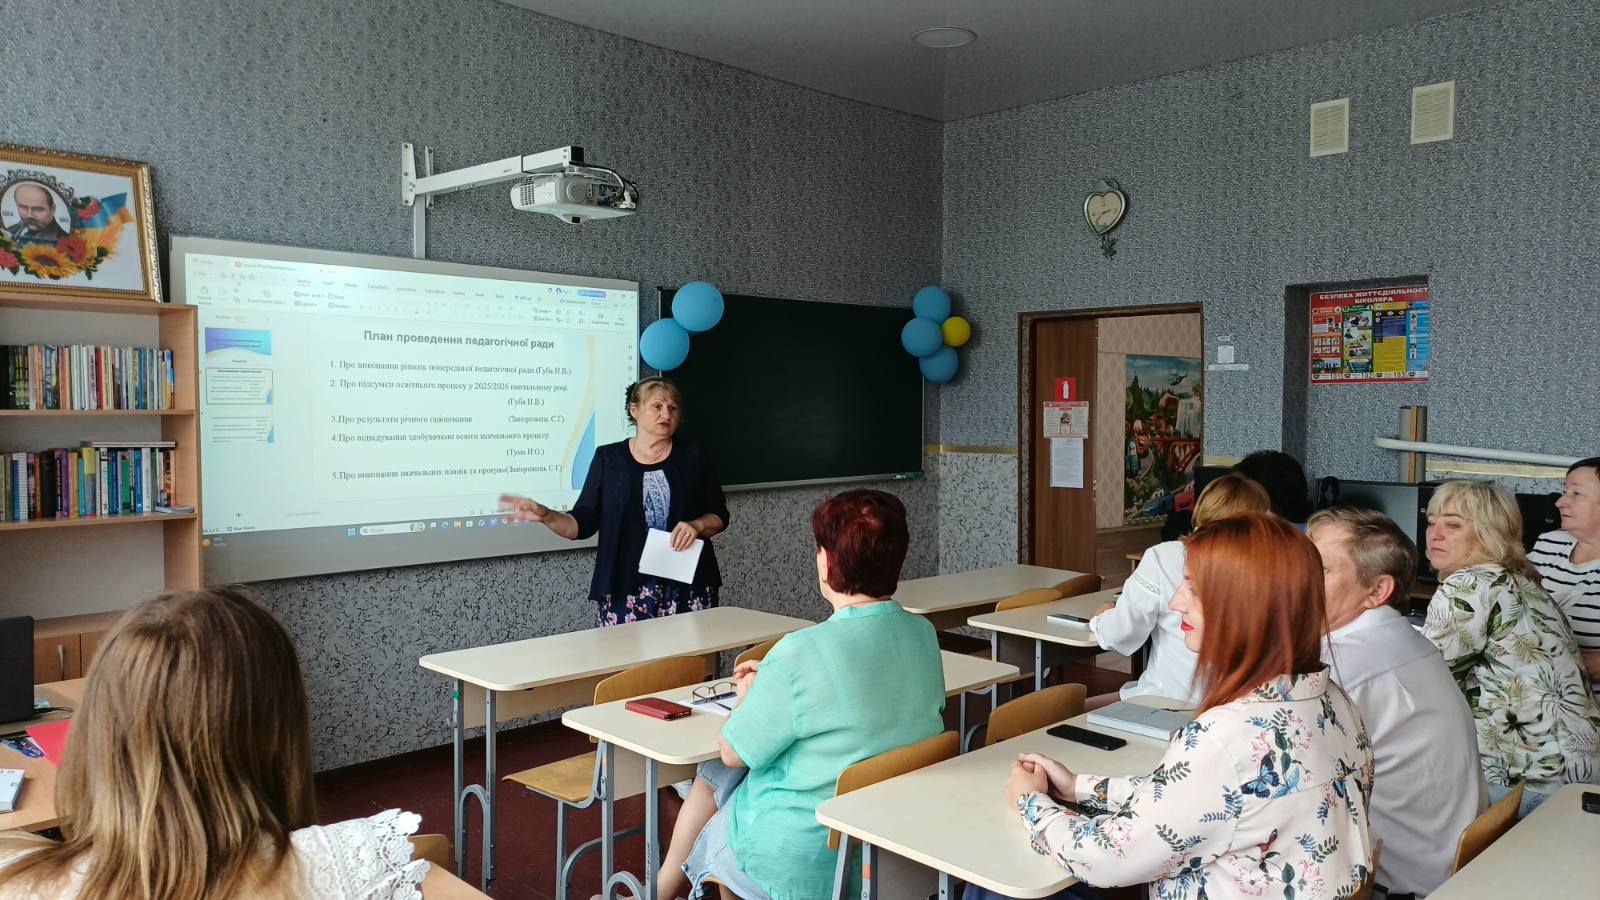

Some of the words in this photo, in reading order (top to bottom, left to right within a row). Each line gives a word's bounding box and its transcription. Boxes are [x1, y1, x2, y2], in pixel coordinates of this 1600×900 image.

[1355, 296, 1394, 304] ШКОЛЯРА
[363, 330, 393, 341] План
[396, 334, 463, 344] проведення
[465, 336, 529, 347] педагогічної
[530, 339, 555, 350] ради
[339, 361, 356, 370] Про
[340, 380, 356, 390] Про
[358, 381, 394, 390] підсумки
[395, 381, 436, 389] освітнього
[437, 383, 467, 391] процесу
[474, 382, 510, 390] 2025/2026
[553, 384, 568, 392] році
[507, 397, 526, 407] (Губа
[356, 416, 399, 424] результати
[400, 415, 428, 424] річного
